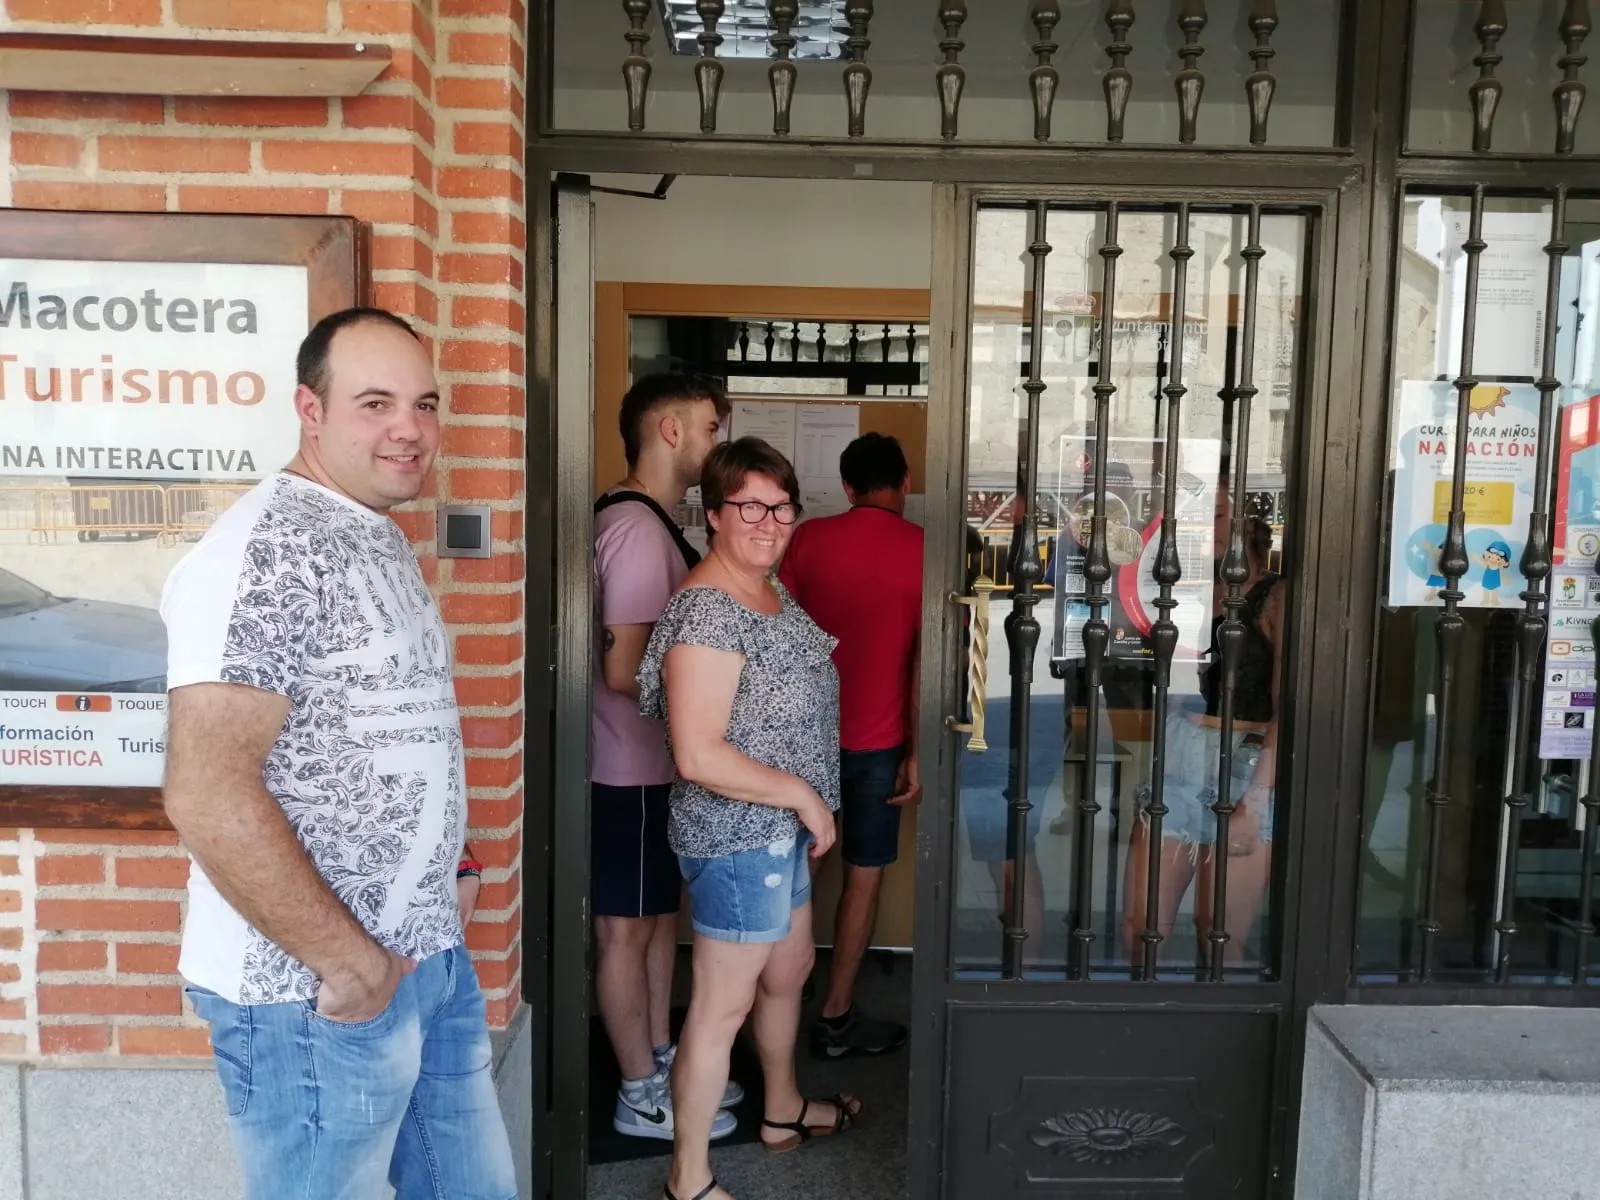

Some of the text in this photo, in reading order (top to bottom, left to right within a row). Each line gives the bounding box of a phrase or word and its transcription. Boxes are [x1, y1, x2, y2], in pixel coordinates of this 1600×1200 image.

[0, 281, 258, 334] Macotera
[0, 354, 266, 406] Turismo
[1420, 425, 1454, 437] CUR
[1500, 424, 1536, 438] NIÑOS
[1418, 438, 1536, 457] NAACIÓN
[56, 446, 256, 471] INTERACTIVA
[3, 698, 47, 709] TOUCH
[118, 699, 164, 711] TOQUE
[0, 725, 94, 741] formación
[2, 745, 103, 767] URÍSTICA
